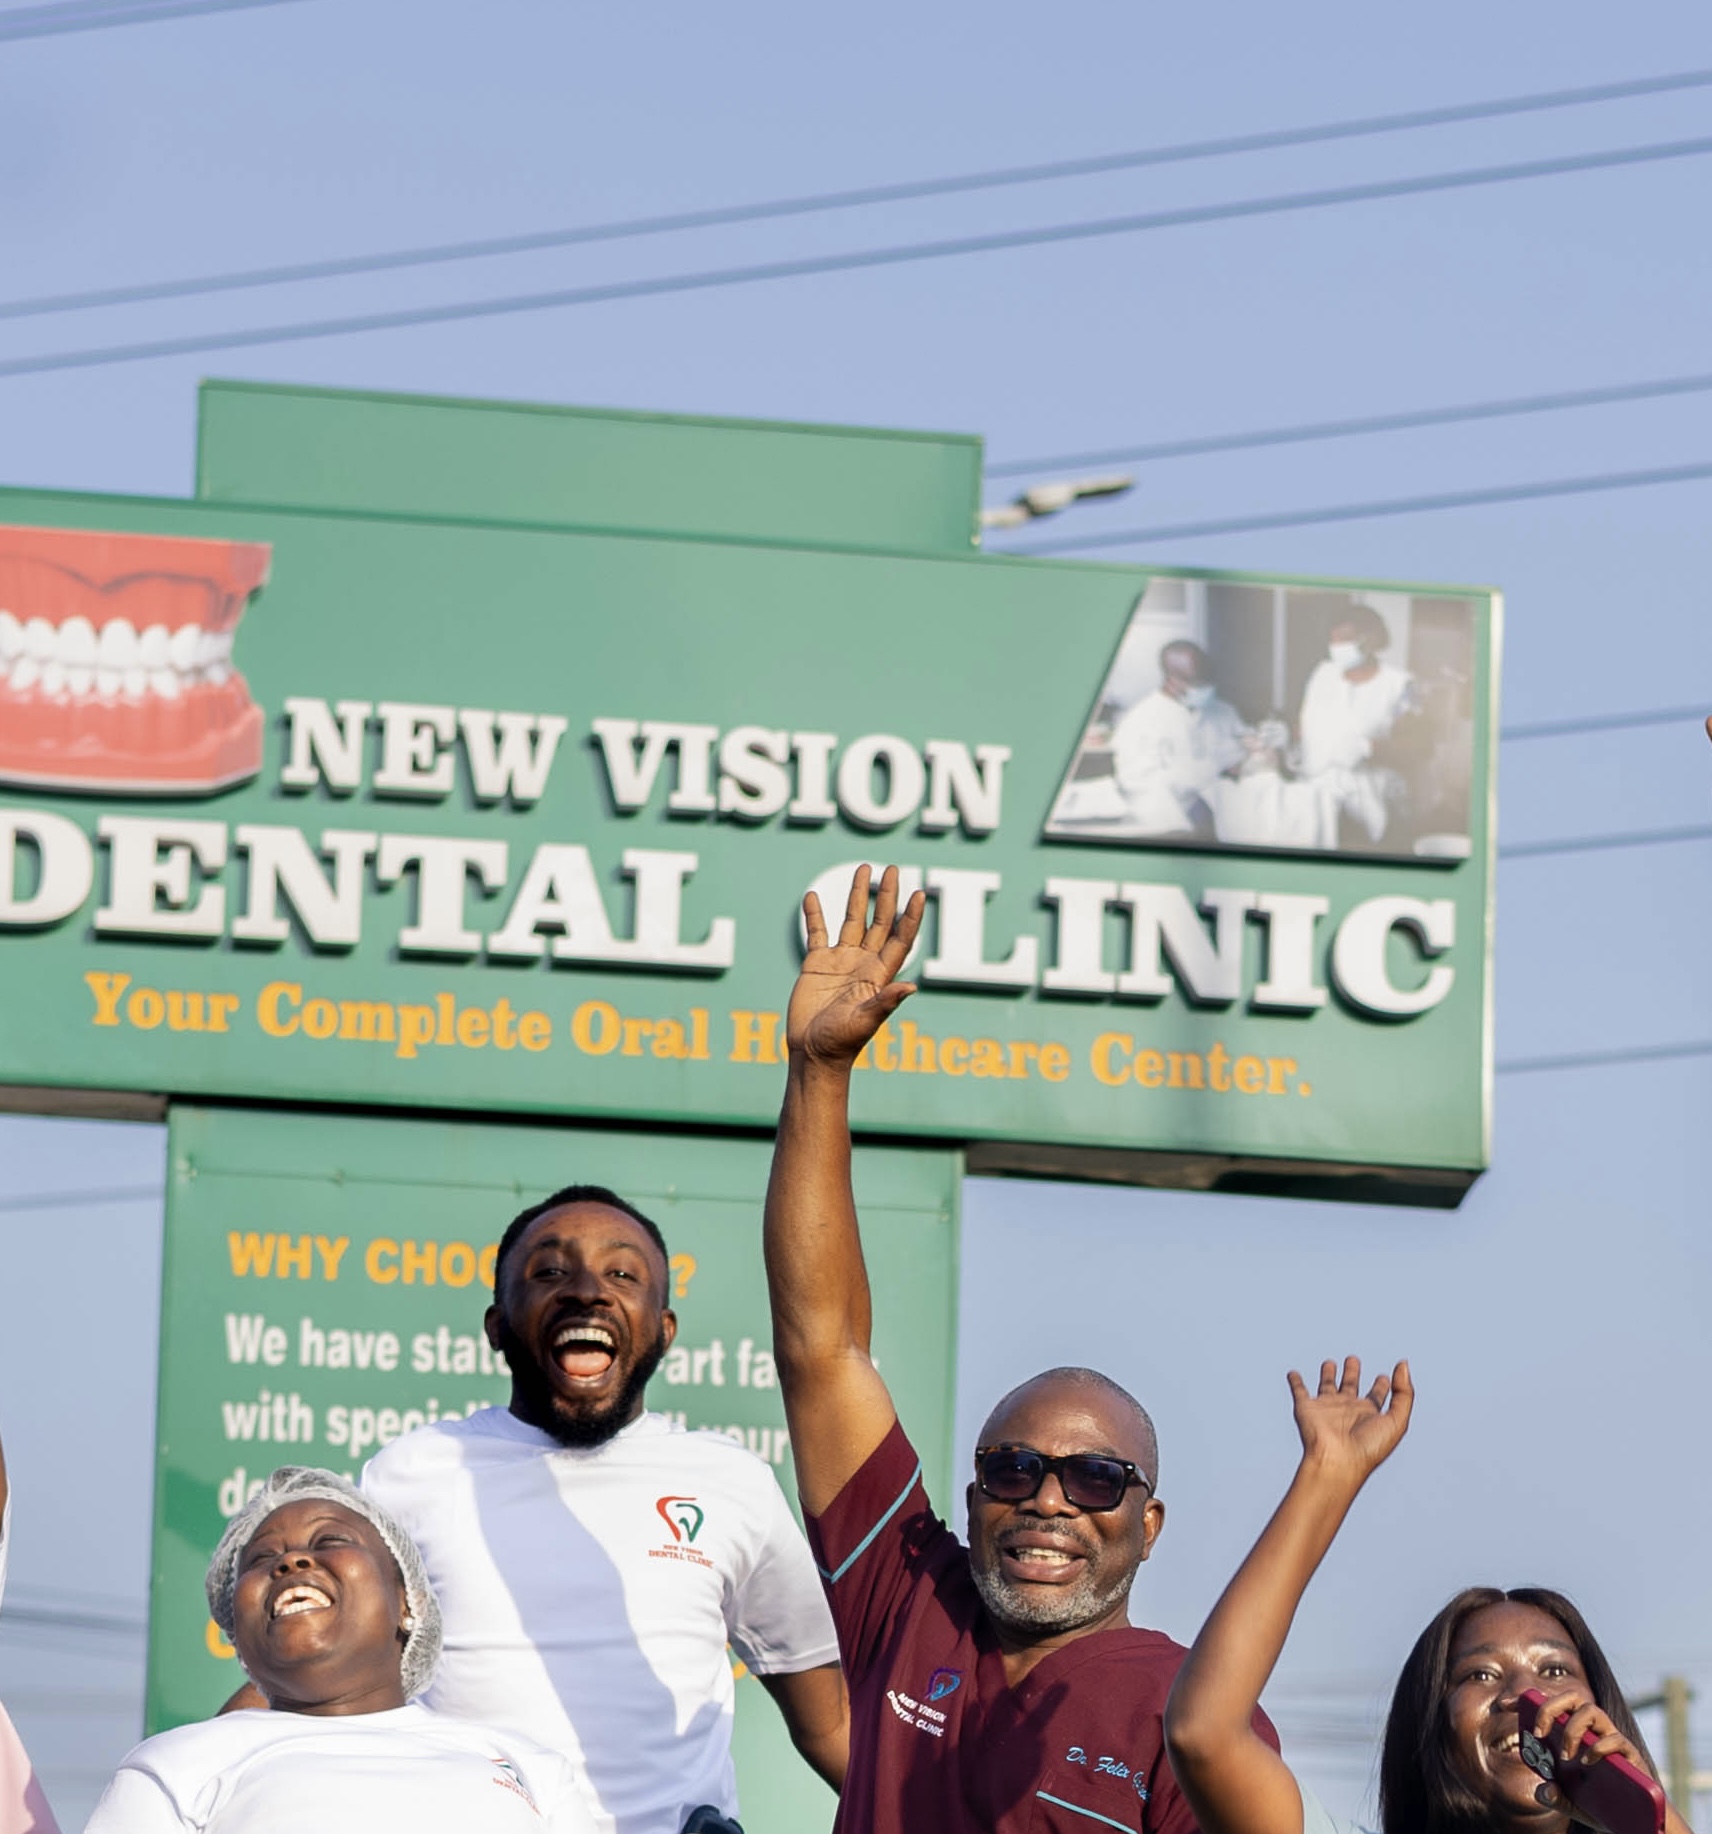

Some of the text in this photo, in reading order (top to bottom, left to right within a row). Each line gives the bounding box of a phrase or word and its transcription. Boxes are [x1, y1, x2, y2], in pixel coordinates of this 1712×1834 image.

[282, 697, 1013, 835] NEW VISION
[85, 972, 240, 1034] Your
[257, 981, 553, 1058] Complete
[572, 1000, 709, 1061] Oral
[1090, 1031, 1313, 1097] Center.
[227, 1231, 350, 1281] WHY
[225, 1313, 287, 1366] We
[299, 1317, 400, 1371] have
[222, 1388, 314, 1442] with
[648, 1550, 685, 1560] DENTAL
[916, 1719, 944, 1737] CLINIC
[1094, 1756, 1130, 1778] Felix
